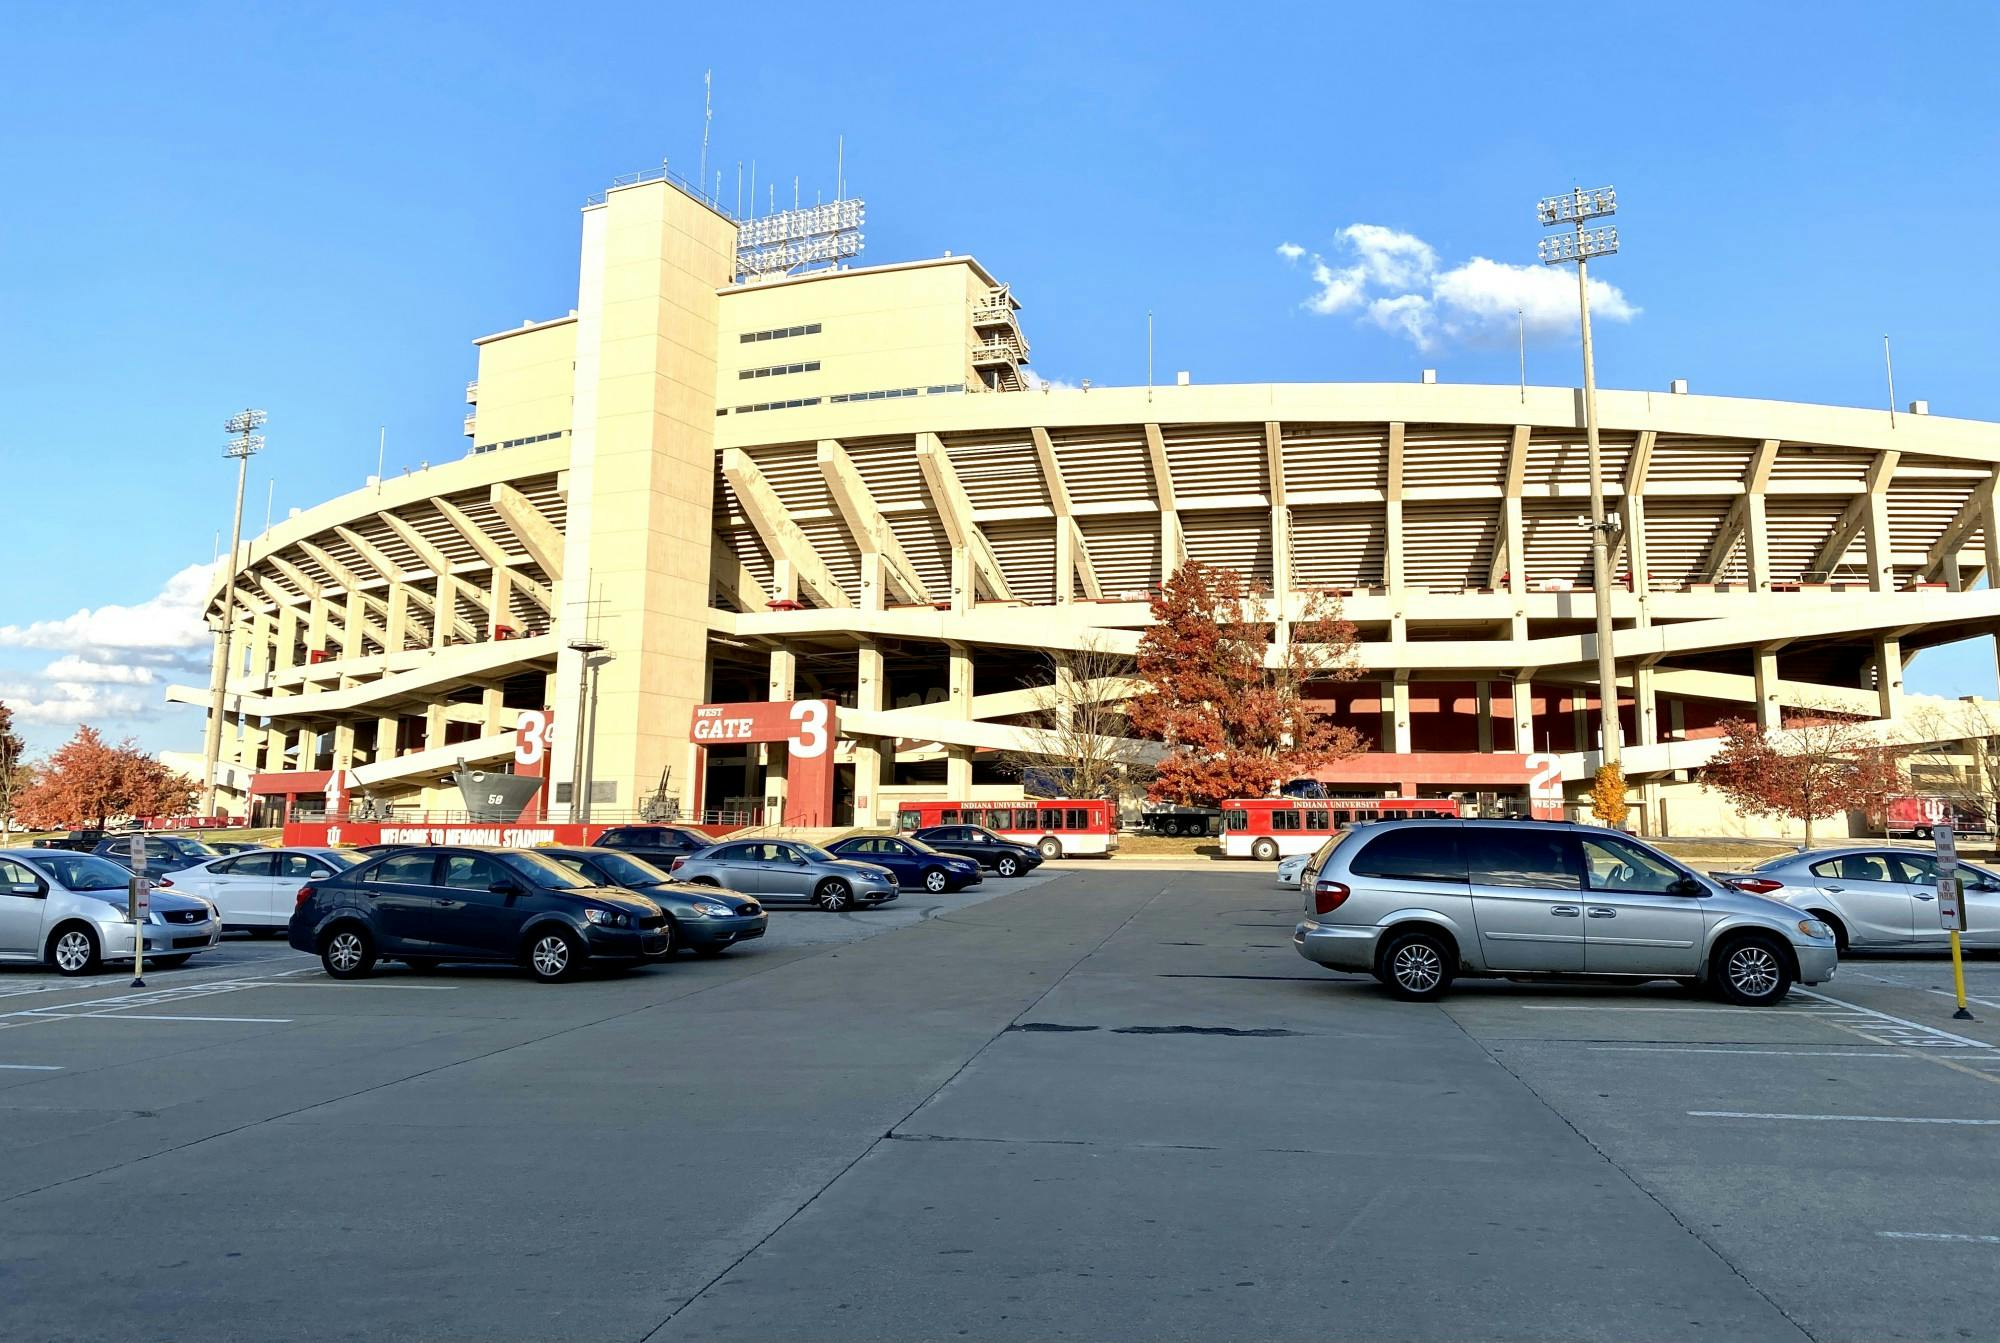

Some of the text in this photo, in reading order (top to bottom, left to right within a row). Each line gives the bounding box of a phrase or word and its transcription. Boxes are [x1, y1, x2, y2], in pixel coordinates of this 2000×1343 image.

[697, 708, 723, 717] WEST
[515, 710, 545, 765] 3
[694, 718, 754, 739] GATE
[788, 700, 828, 758] 3
[1525, 753, 1563, 798] 2
[323, 770, 340, 814] 4
[994, 801, 1038, 809] UNIVERSITY
[1532, 799, 1565, 808] WEST
[380, 828, 555, 848] WELCOME TO MEMORIAL STADIUM
